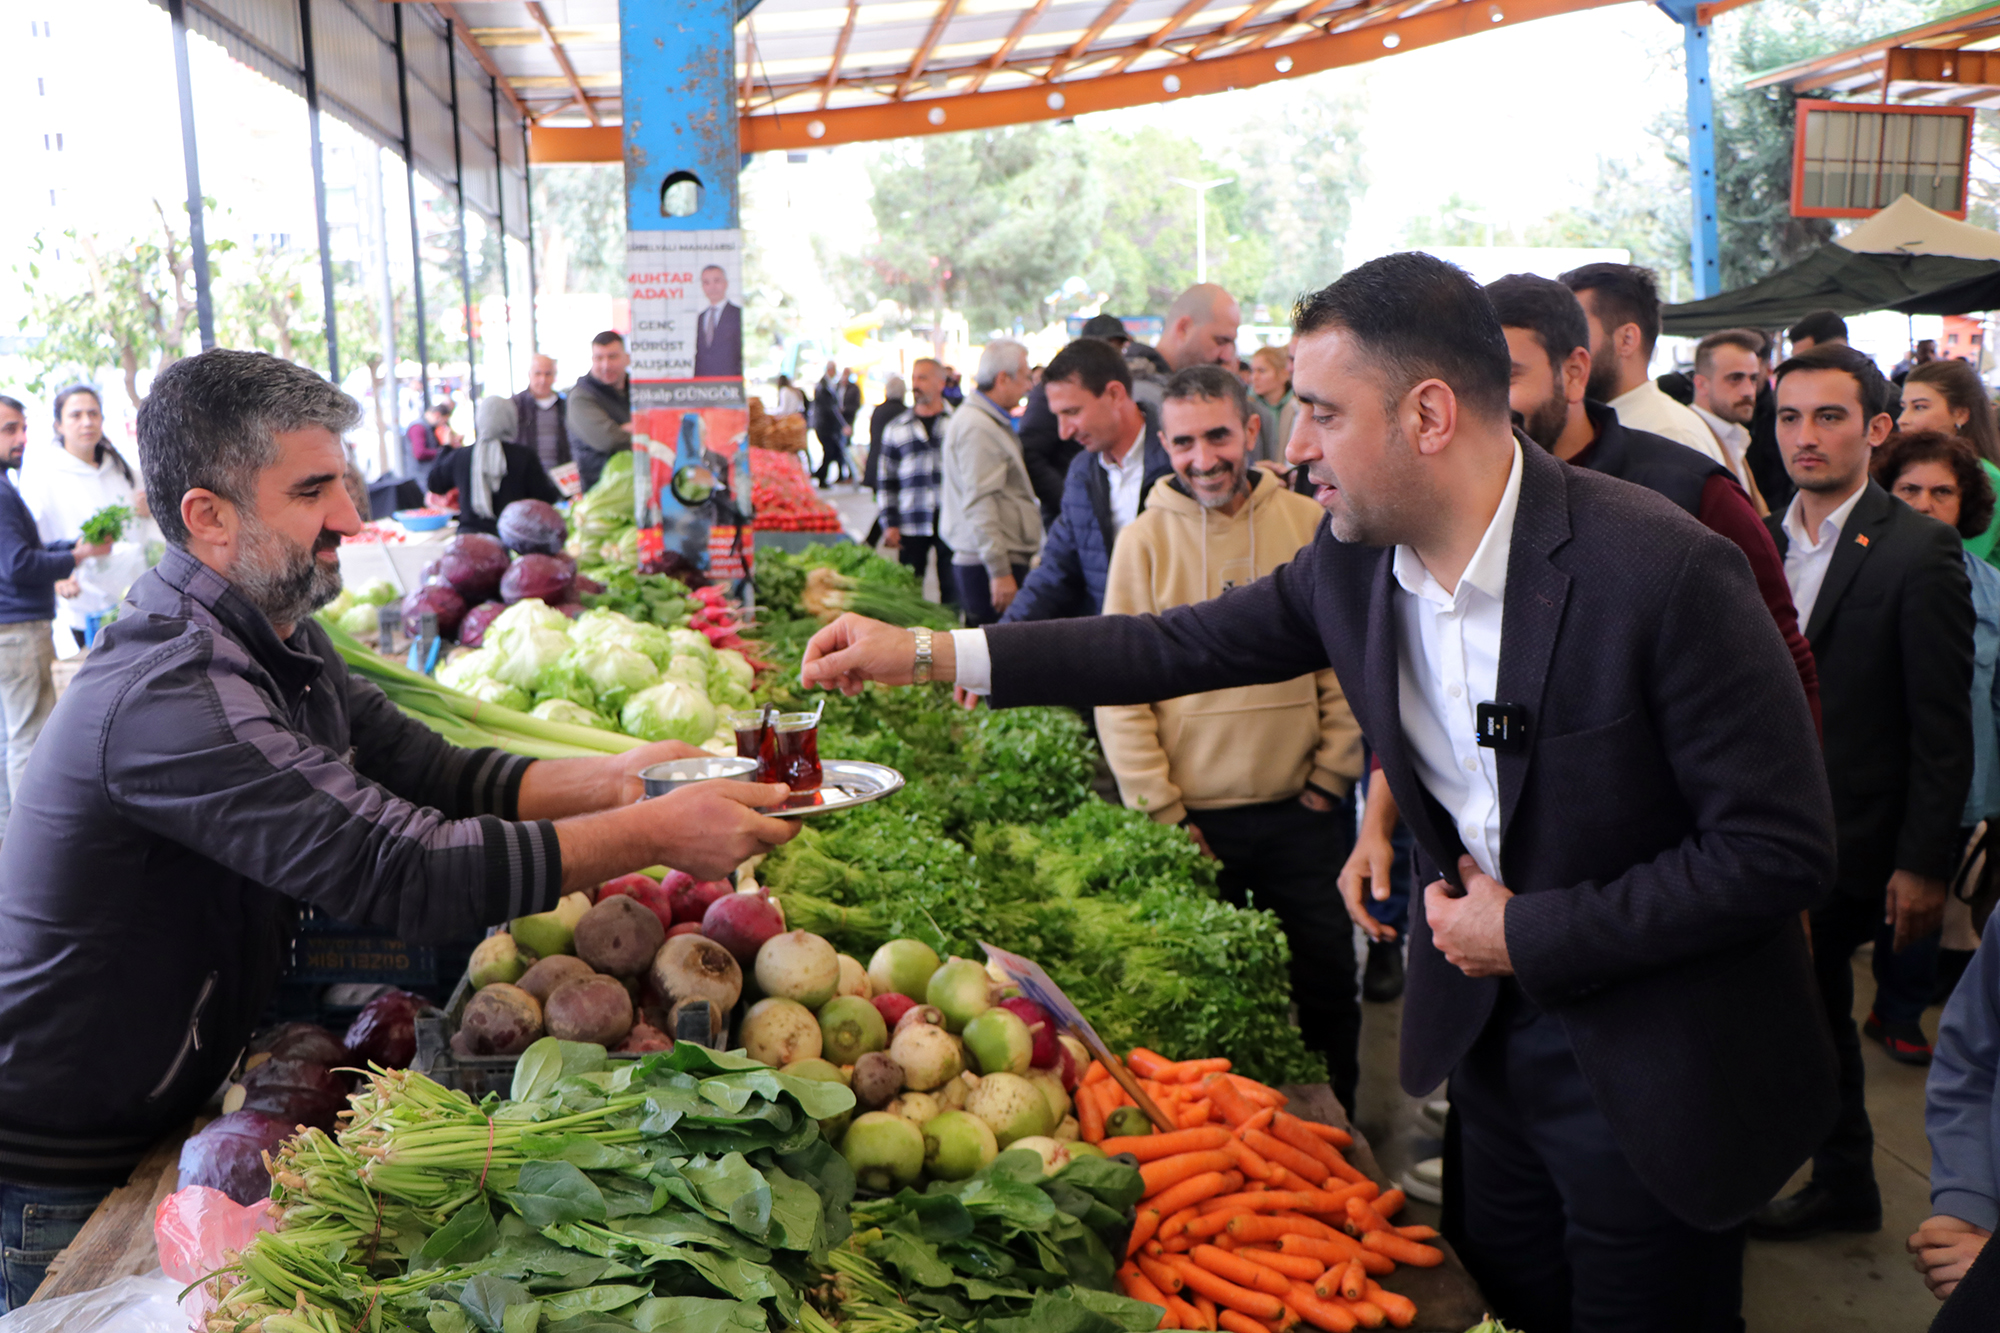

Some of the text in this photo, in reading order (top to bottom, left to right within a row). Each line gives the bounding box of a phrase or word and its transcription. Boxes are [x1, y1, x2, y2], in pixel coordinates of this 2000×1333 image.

[632, 287, 684, 299] ADAYI
[638, 320, 676, 331] GENÇ
[631, 339, 685, 352] DÜRÜST
[632, 358, 692, 371] ALIŞKAN
[674, 385, 741, 401] GÜNGÖR
